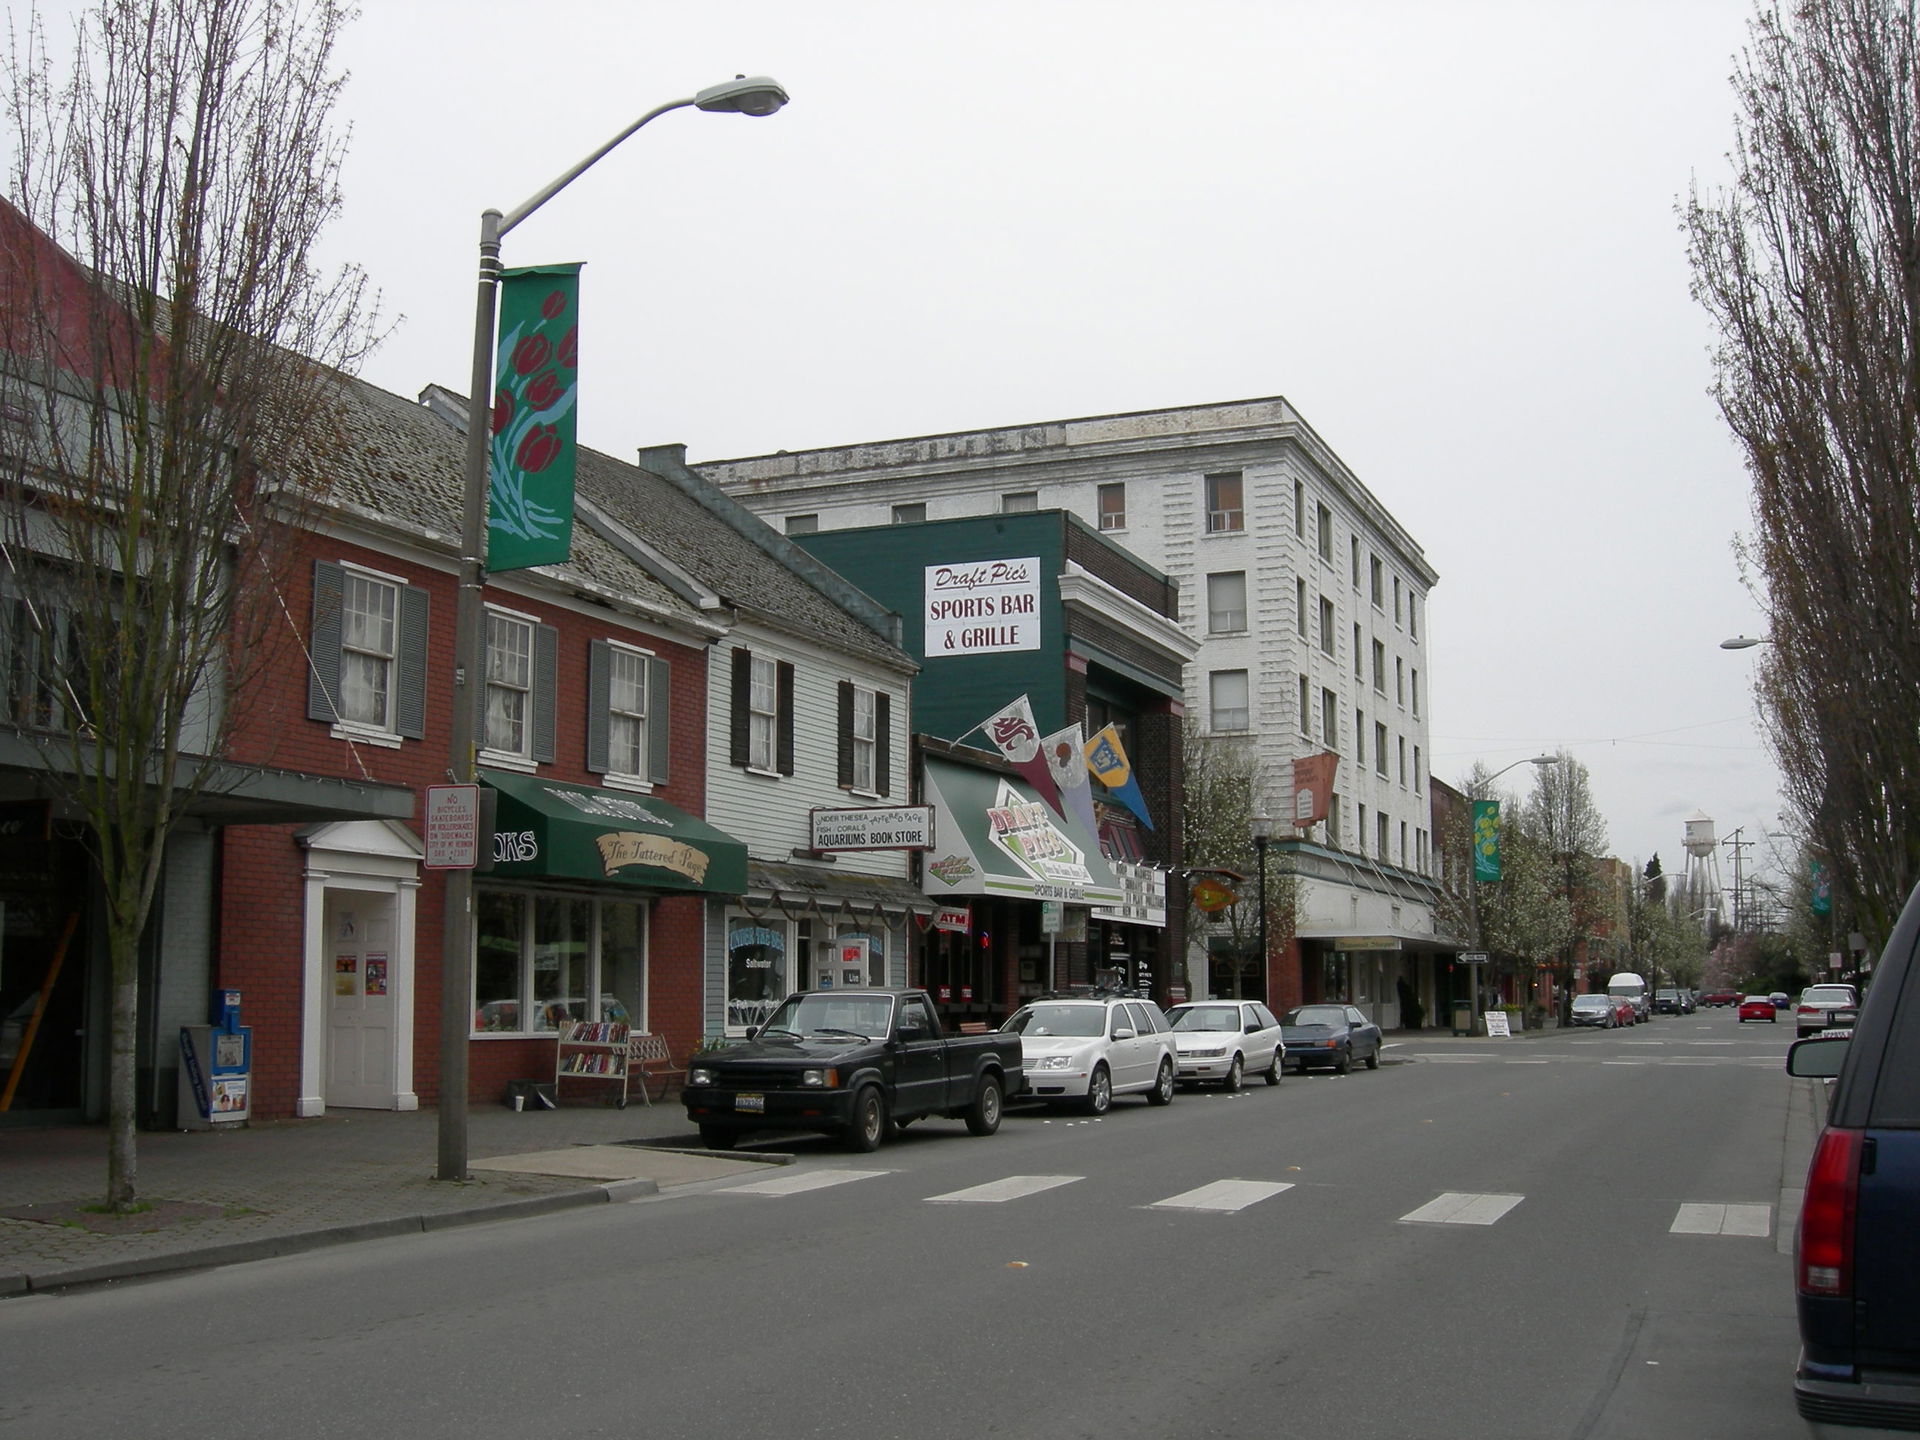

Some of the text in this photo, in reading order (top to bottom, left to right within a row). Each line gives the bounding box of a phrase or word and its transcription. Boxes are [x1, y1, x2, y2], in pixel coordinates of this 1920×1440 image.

[935, 562, 1029, 591] Draft Pic's
[930, 593, 1035, 621] SPORTS BAR
[943, 625, 1020, 650] & GRILLE
[447, 796, 458, 804] NO
[437, 805, 466, 813] BICYCLES
[431, 814, 473, 822] SKATEBOARDS
[815, 814, 840, 825] UNDER
[904, 812, 923, 824] PAGE
[986, 802, 1048, 835] DRAFT
[837, 824, 866, 833] CORALS
[429, 831, 474, 840] ON SIDEWALKS
[818, 833, 866, 847] AQUARIUMS
[870, 831, 922, 844] BOOK STORE
[607, 841, 703, 877] The Tattered Page
[1034, 884, 1053, 897] SPORTS
[1054, 886, 1063, 898] BAR
[940, 911, 967, 925] ATM
[745, 958, 772, 969] Saltwater
